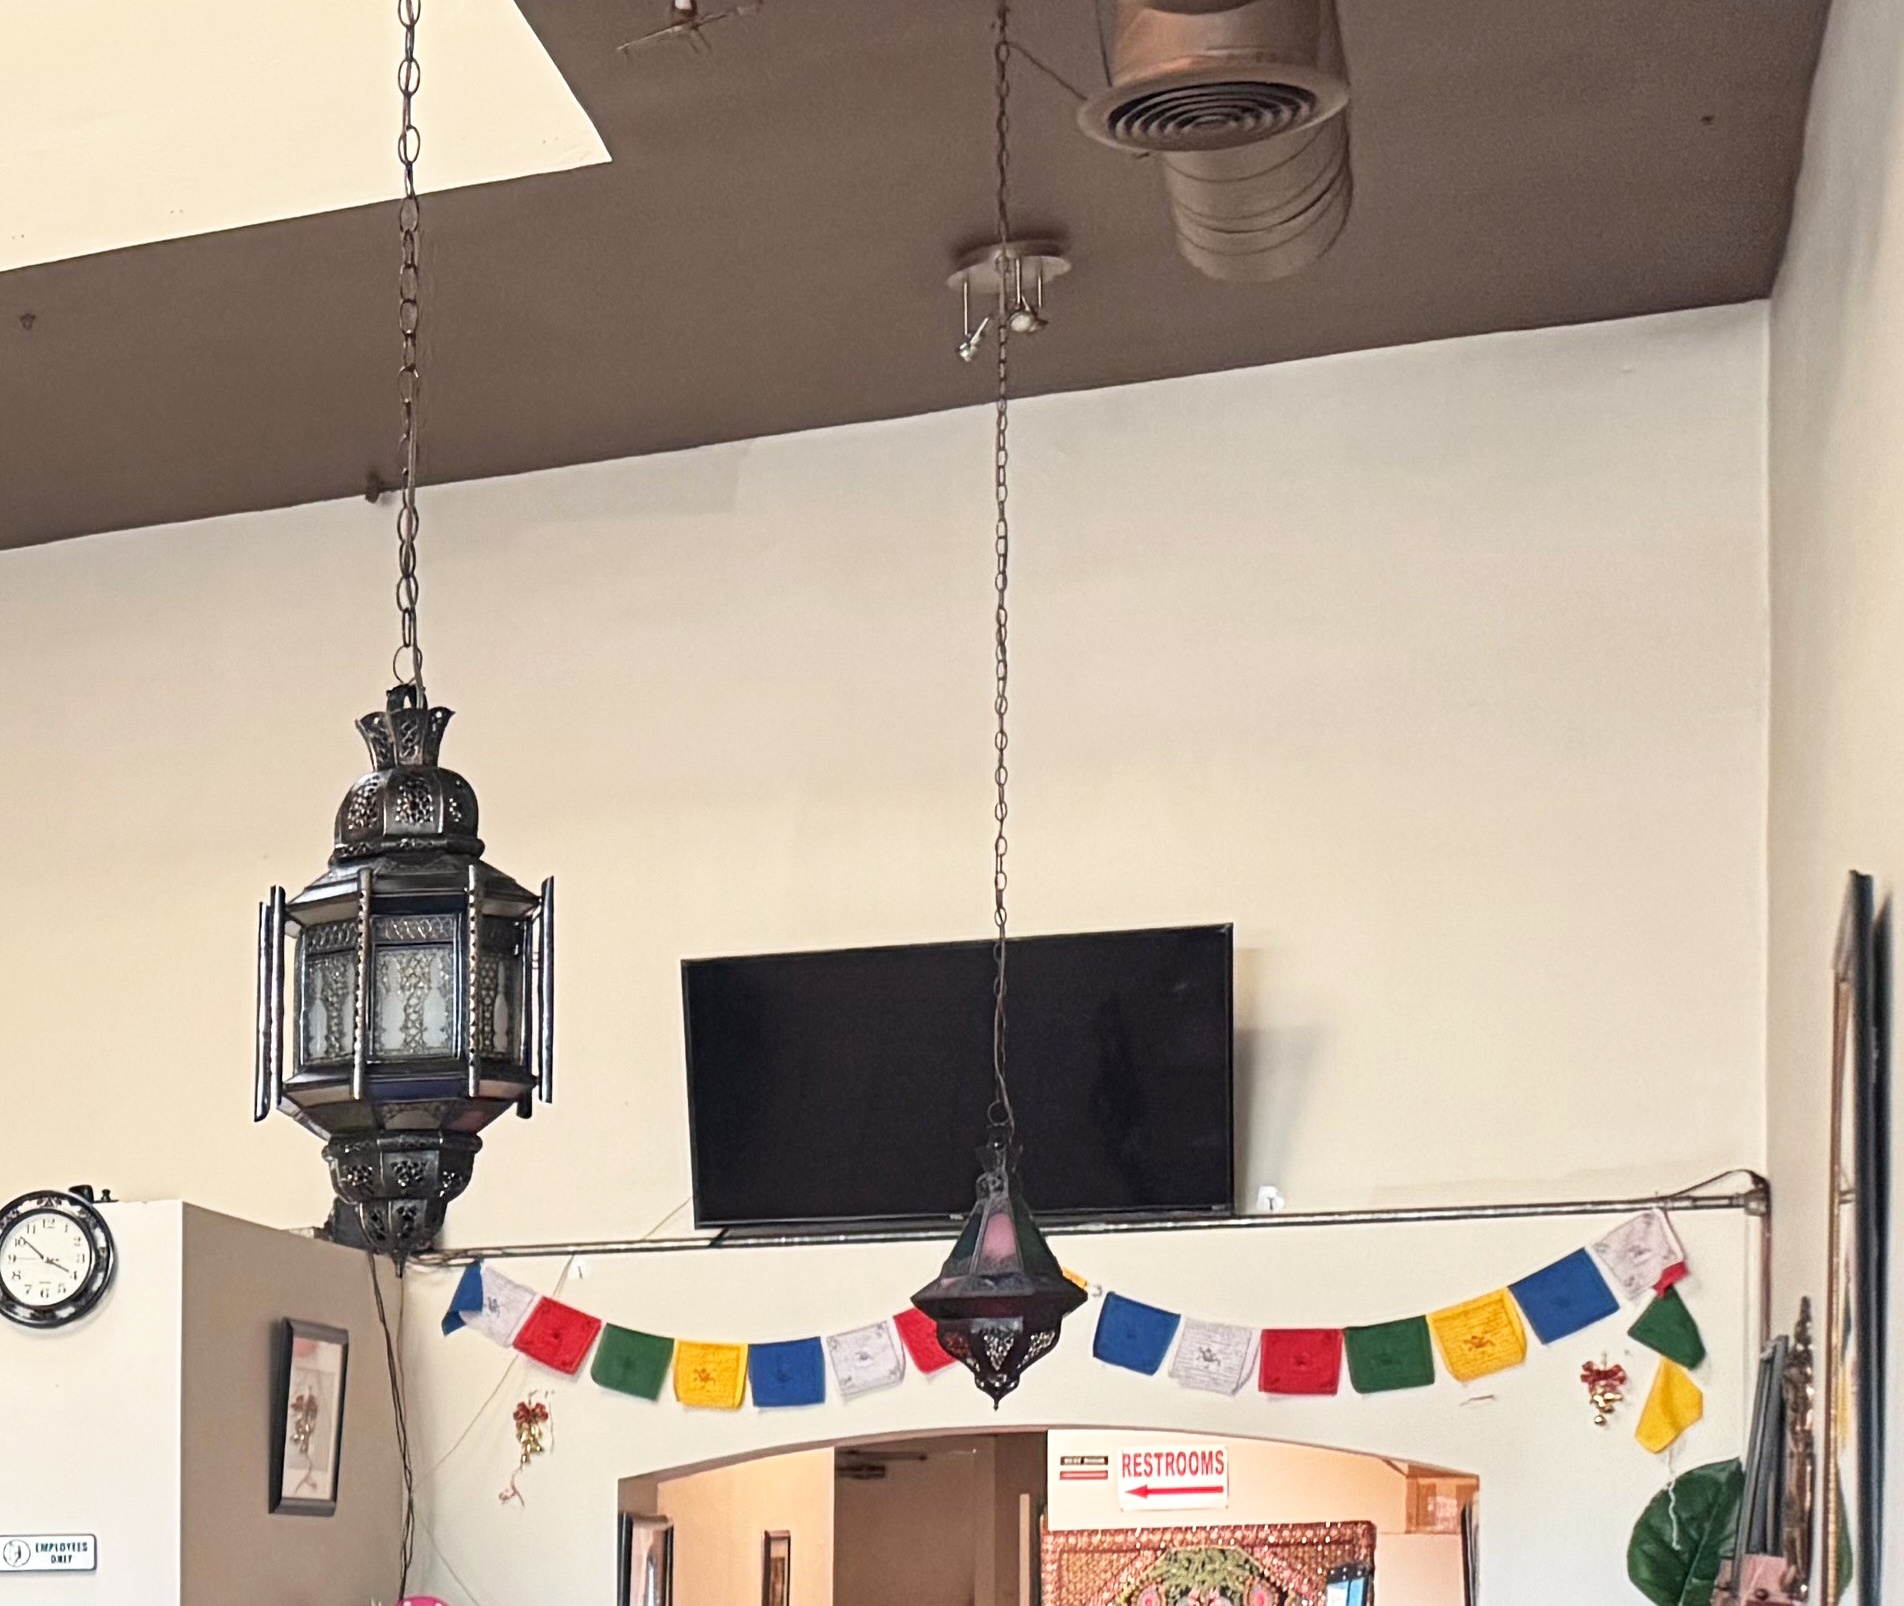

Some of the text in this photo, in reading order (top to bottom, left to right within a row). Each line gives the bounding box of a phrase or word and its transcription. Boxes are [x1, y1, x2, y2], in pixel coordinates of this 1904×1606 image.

[26, 1223, 36, 1234] 11
[42, 1218, 55, 1229] 12
[64, 1224, 68, 1233] 1
[14, 1237, 26, 1247] 10
[73, 1236, 81, 1246] 2
[8, 1254, 16, 1263] 9
[76, 1253, 85, 1263] 3
[11, 1270, 21, 1280] 8
[69, 1270, 77, 1280] 4
[24, 1284, 32, 1294] 7
[40, 1288, 49, 1298] 6
[57, 1283, 66, 1293] 5
[1121, 1450, 1224, 1478] RESTROOMS
[35, 1542, 88, 1553] EMPLOYEES
[51, 1554, 73, 1564] ONLY
